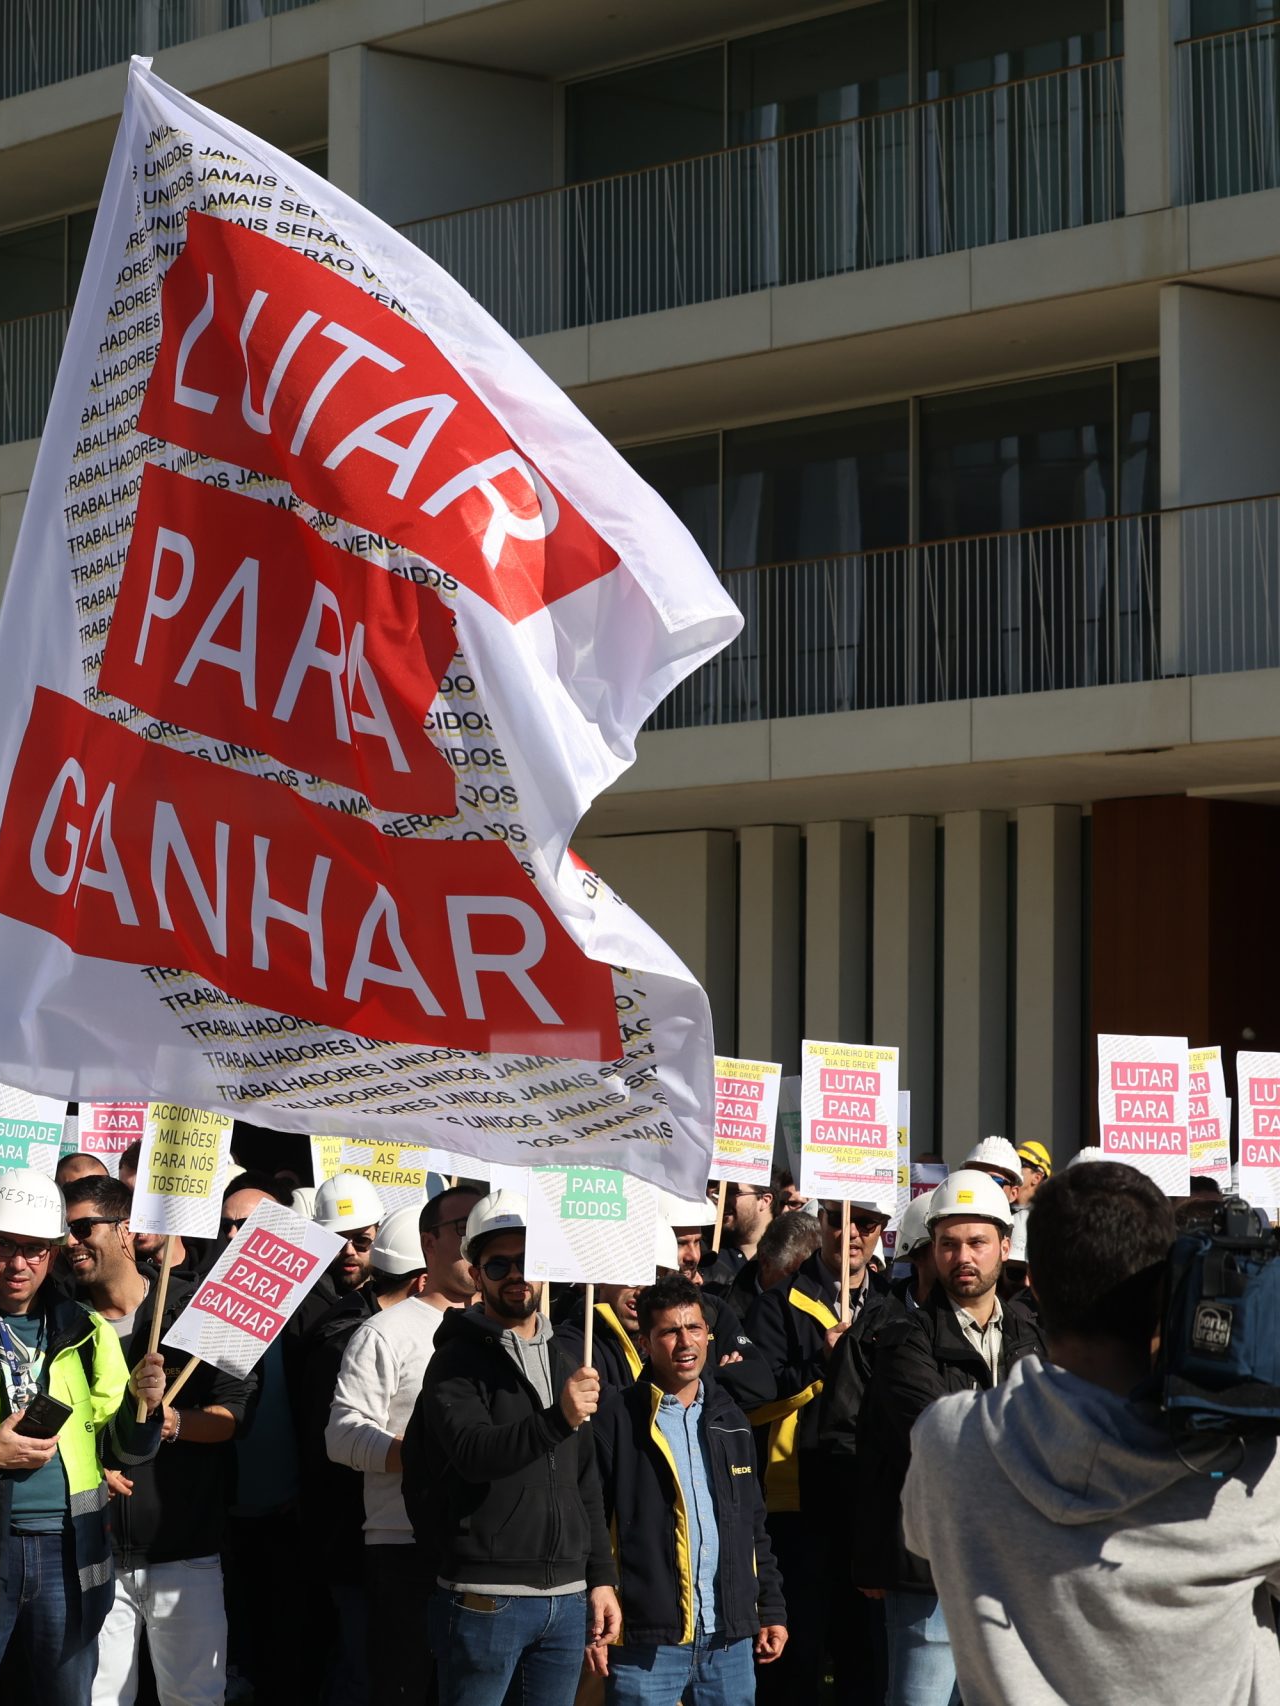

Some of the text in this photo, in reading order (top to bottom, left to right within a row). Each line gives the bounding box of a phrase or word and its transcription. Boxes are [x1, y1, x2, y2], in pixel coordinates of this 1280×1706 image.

[144, 143, 193, 176] UNIDOS
[144, 171, 193, 204] UNIDOS
[198, 168, 277, 187] JAMAIS
[200, 192, 272, 211] JAMAIS
[174, 272, 558, 570] LUTAR
[133, 526, 412, 774] PARA
[29, 757, 566, 1026] GANHAR
[202, 1039, 357, 1069] TRABALHADORES
[820, 1047, 829, 1055] DE
[831, 1048, 862, 1057] JANEIRO
[865, 1051, 874, 1059] DE
[876, 1052, 893, 1060] 2024
[840, 1059, 850, 1067] DE
[852, 1060, 876, 1069] GREVE
[216, 1063, 384, 1101] TRABALHADORES
[409, 1067, 491, 1088] UNIDOS
[825, 1074, 875, 1092] LUTAR
[1116, 1068, 1173, 1088] LUTAR
[436, 1073, 598, 1104] UNIDOS JAMAIS
[715, 1080, 760, 1098] LUTAR
[464, 1092, 625, 1129] UNIDOS JAMAIS
[715, 1101, 753, 1118] PARA
[829, 1100, 871, 1118] PARA
[1121, 1100, 1169, 1118] PARA
[98, 1115, 139, 1128] PARA
[575, 1105, 653, 1139] JAMAIS
[159, 1129, 217, 1148] MILHÕES!
[815, 1125, 882, 1144] GANHAR
[1108, 1131, 1182, 1151] GANHAR
[377, 1153, 395, 1165] AS
[805, 1145, 843, 1153] VALORIZAR
[855, 1147, 893, 1157] CARREIRAS
[153, 1152, 214, 1171] PARA NÓS
[152, 1173, 208, 1194] TOSTÕES!
[572, 1178, 618, 1194] PARA
[566, 1201, 622, 1217] TODOS
[247, 1235, 309, 1277] LUTAR
[229, 1264, 281, 1302] PARA
[199, 1288, 275, 1337] GANHAR
